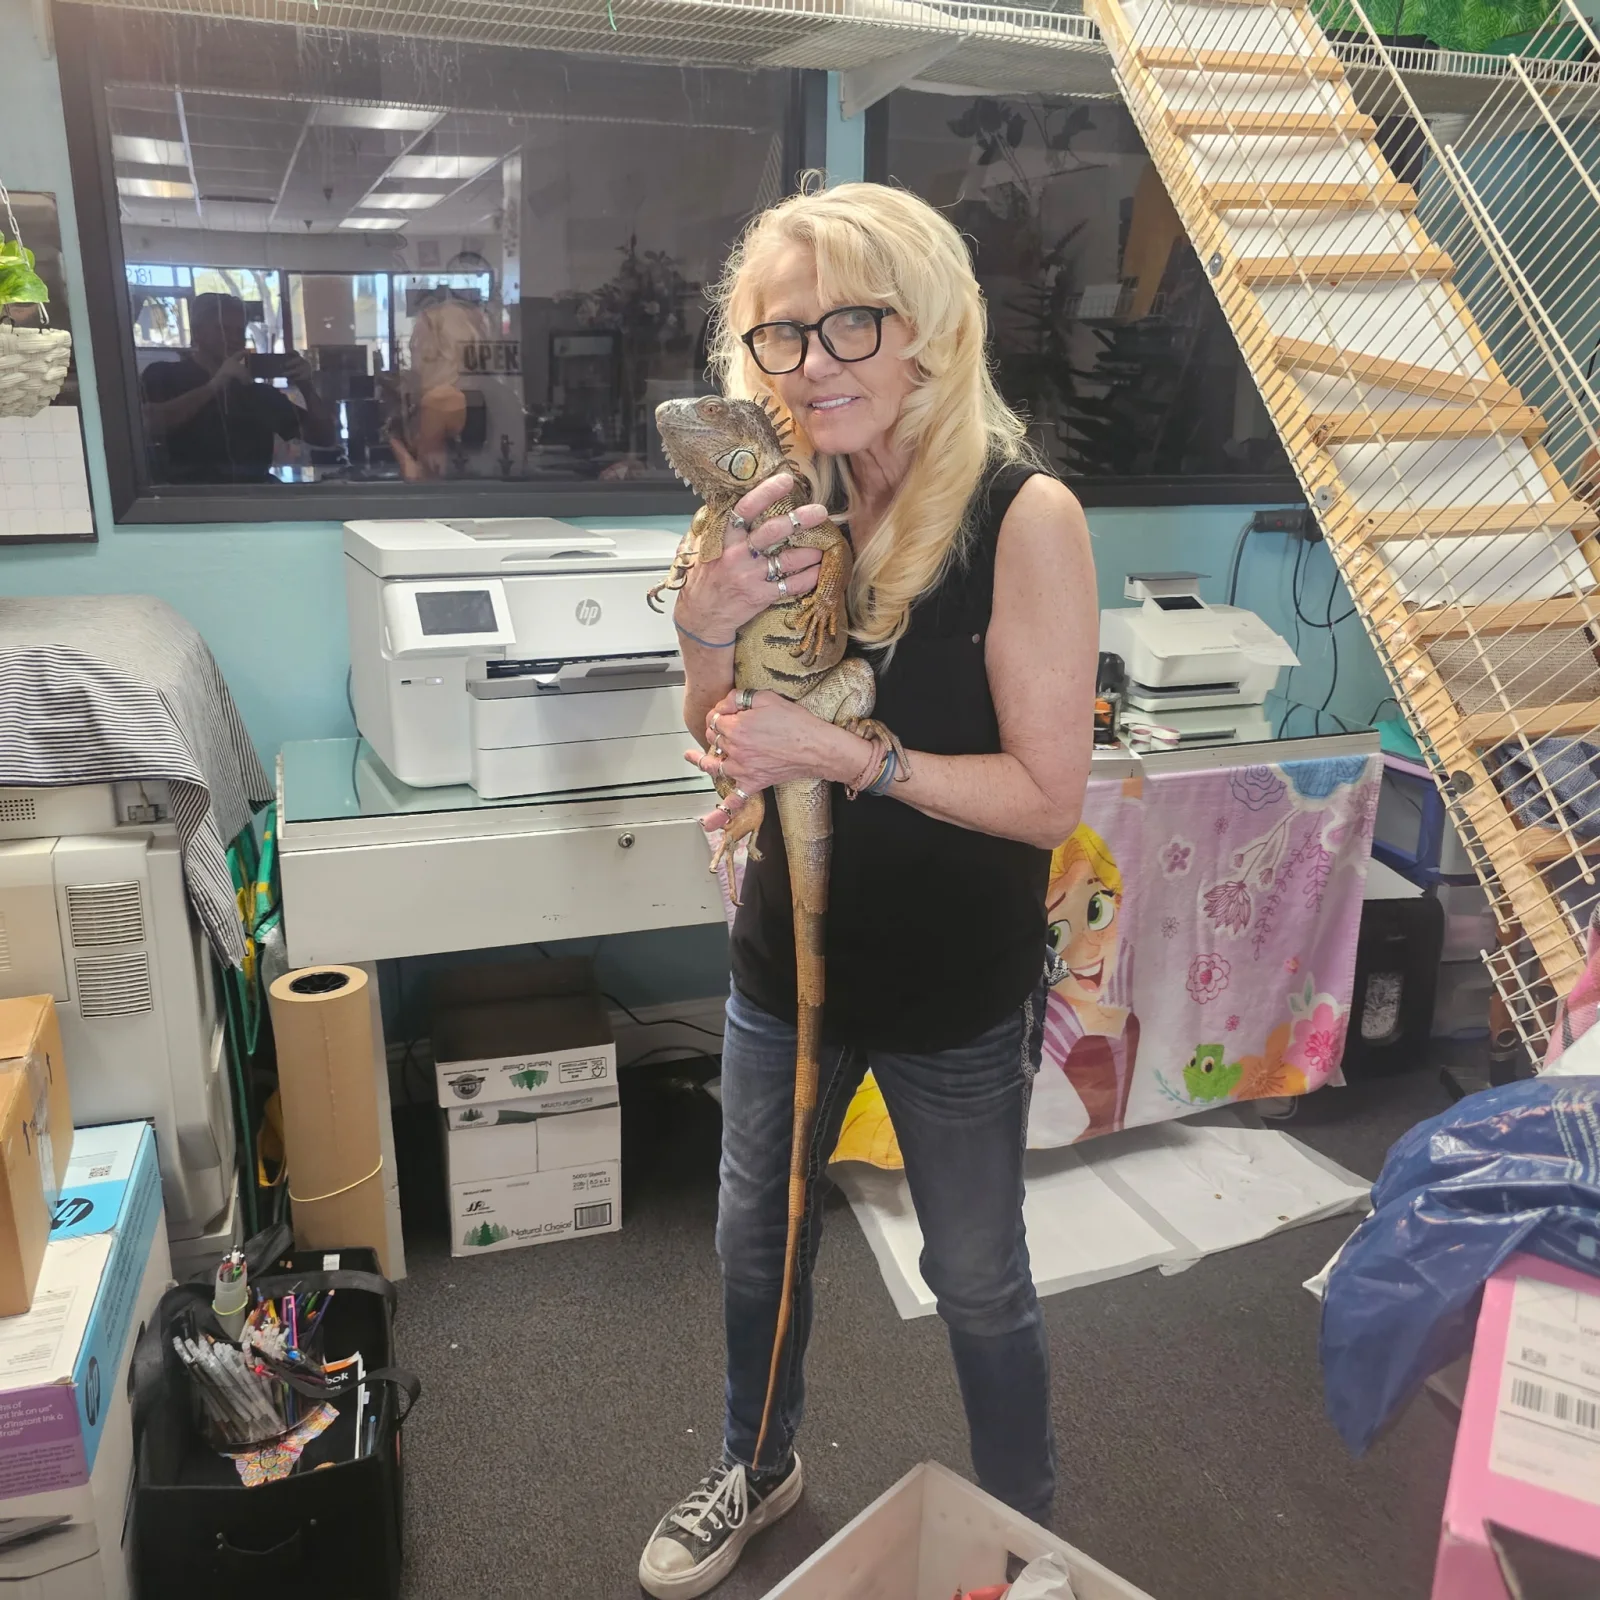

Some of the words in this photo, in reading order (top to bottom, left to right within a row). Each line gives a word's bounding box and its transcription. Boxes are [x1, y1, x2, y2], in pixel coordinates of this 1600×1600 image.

[463, 344, 519, 371] OPEN
[578, 599, 600, 627] hp
[511, 1224, 542, 1237] Natural
